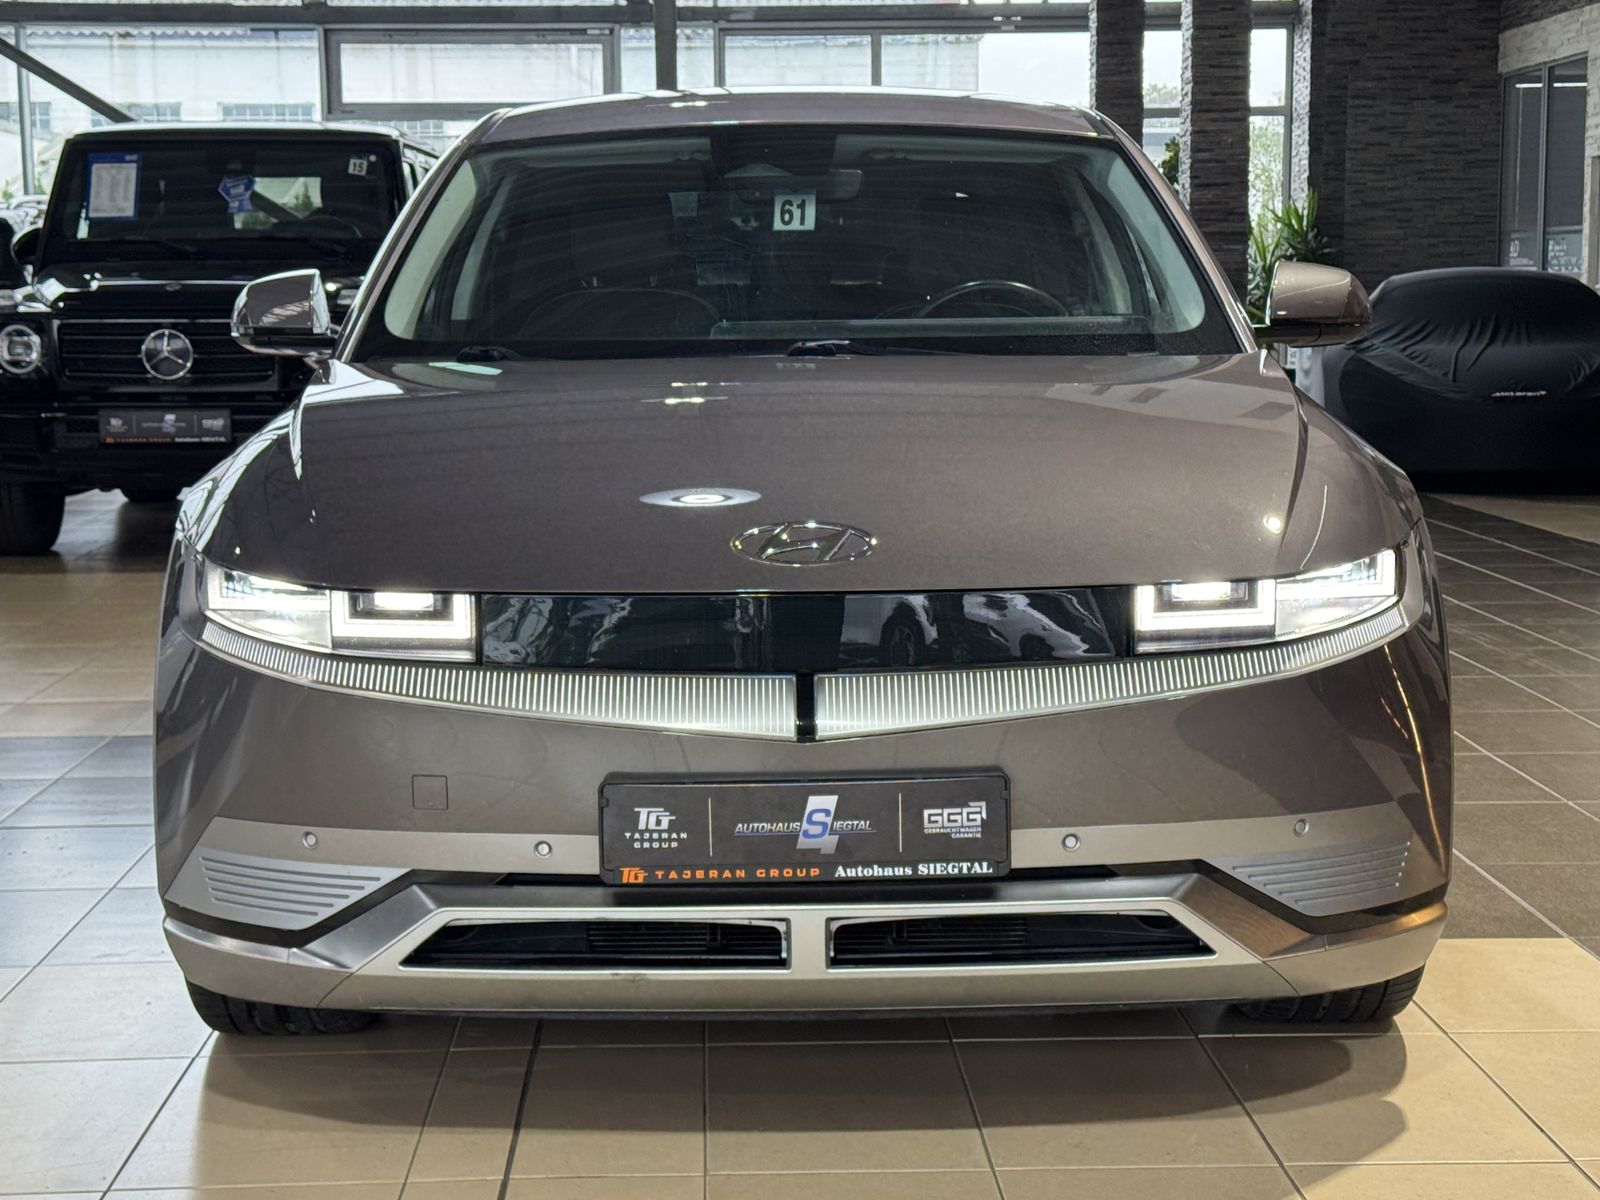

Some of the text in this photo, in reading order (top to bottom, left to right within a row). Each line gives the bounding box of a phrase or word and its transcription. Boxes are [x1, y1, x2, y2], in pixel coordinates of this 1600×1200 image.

[352, 161, 365, 173] 15
[780, 199, 807, 226] 61
[633, 807, 676, 830] TG
[923, 806, 982, 828] GGG
[624, 832, 688, 840] TAJERAN
[734, 821, 801, 834] AUTOHAUS
[633, 841, 679, 849] GROUP
[619, 861, 993, 884] TG TAJERAN GROUP Autohaus SIEGTAL
